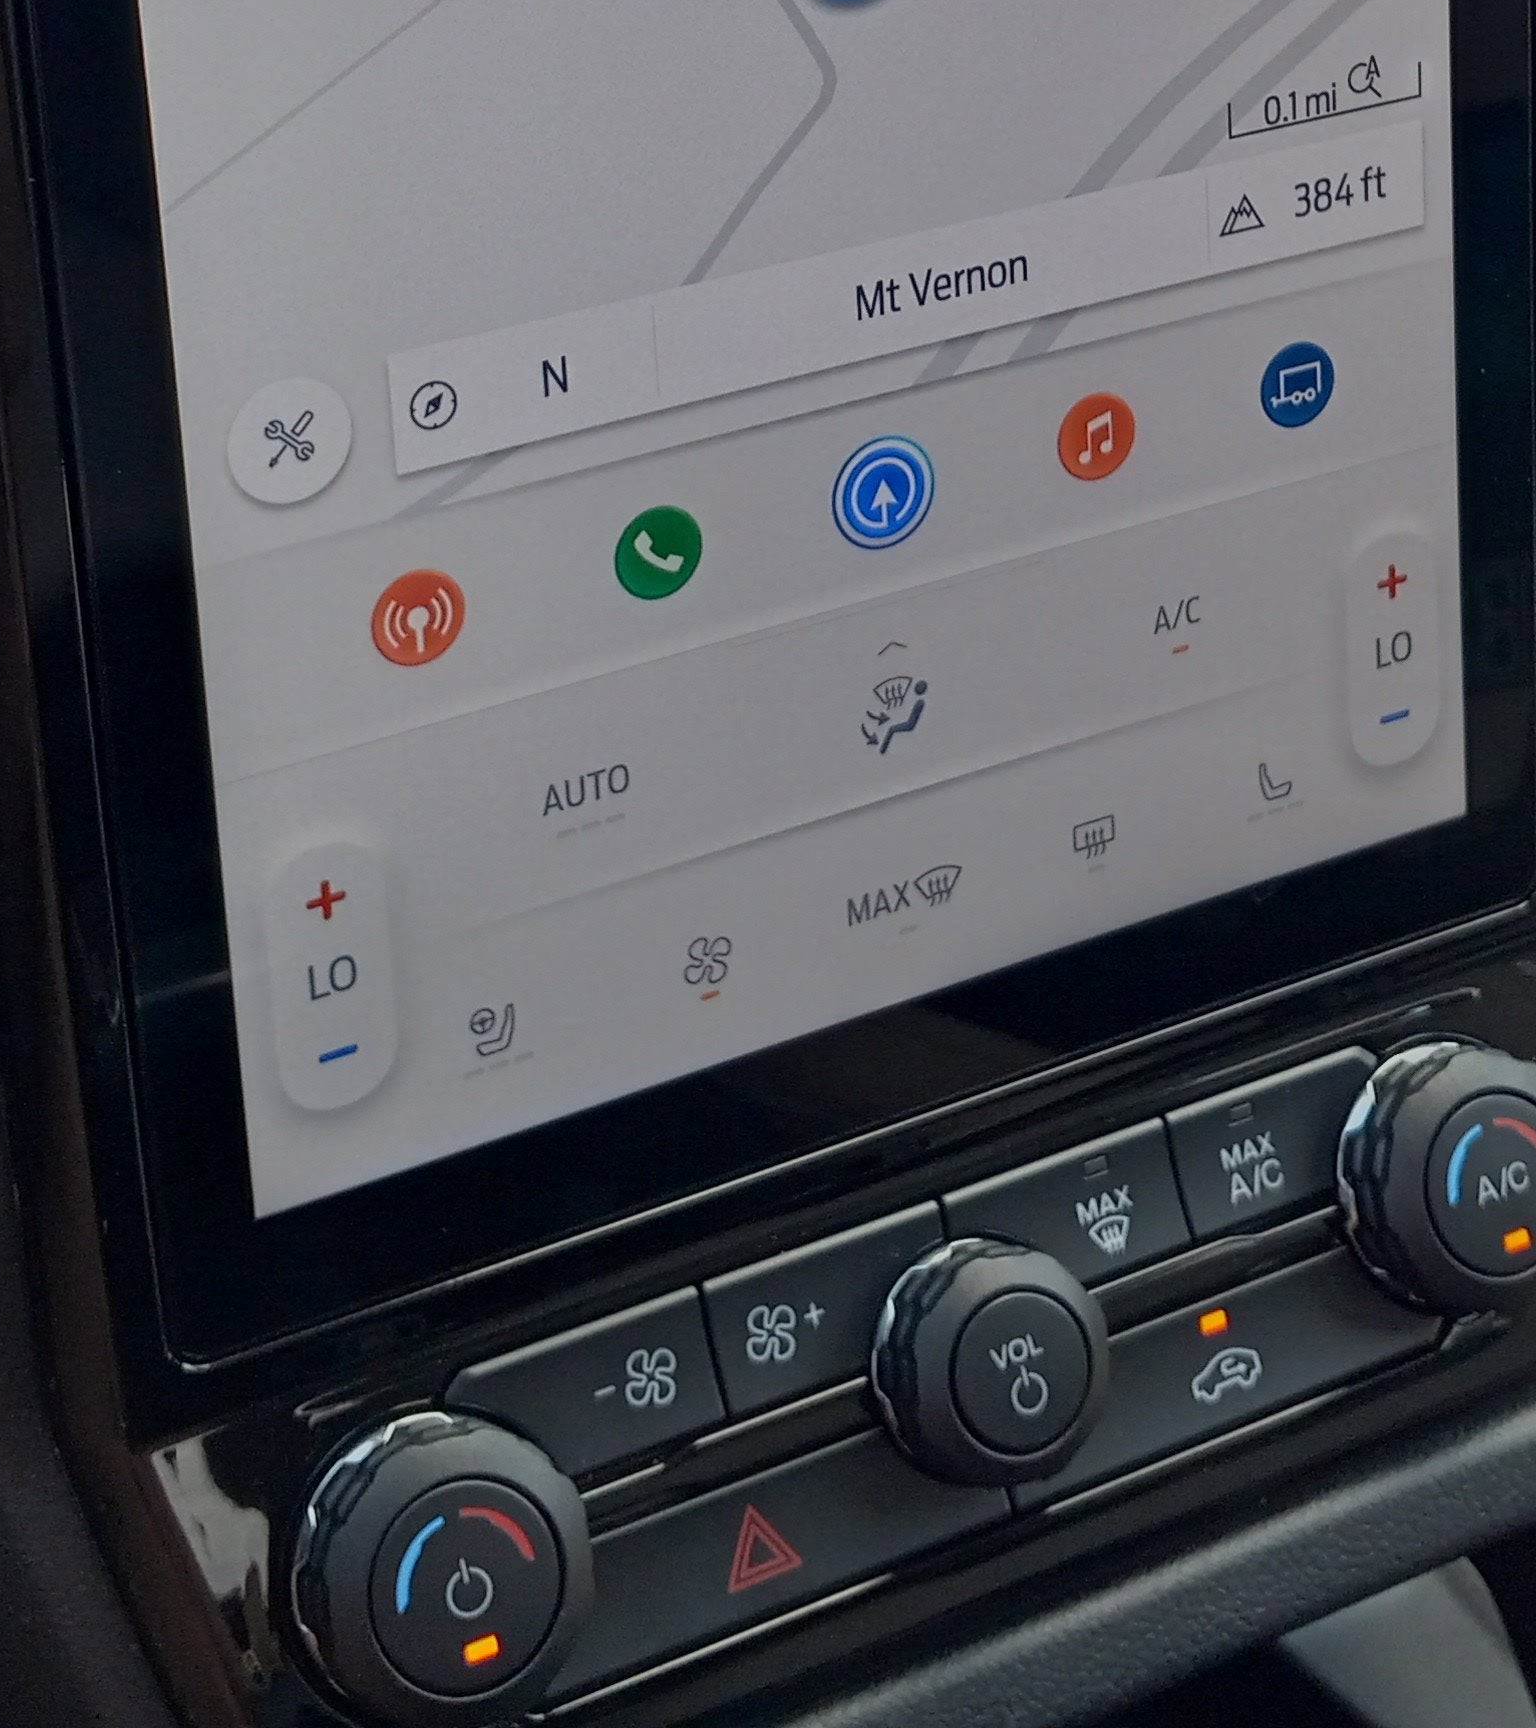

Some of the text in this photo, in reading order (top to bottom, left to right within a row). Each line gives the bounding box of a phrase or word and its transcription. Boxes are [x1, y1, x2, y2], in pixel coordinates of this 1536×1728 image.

[1263, 82, 1338, 126] 0.1 mi
[1294, 165, 1387, 218] 384 ft
[854, 253, 1030, 321] Mt Vernon
[541, 355, 570, 398] N
[1153, 595, 1202, 636] A/C
[1375, 630, 1414, 671] LO
[542, 763, 631, 817] AUTO
[847, 880, 912, 928] MAX
[307, 954, 358, 1002] LO
[1218, 1130, 1277, 1172] MAX
[1228, 1156, 1286, 1206] A/C
[1476, 1159, 1531, 1207] A/C
[1075, 1184, 1136, 1228] MAX
[988, 1333, 1045, 1371] VOL
